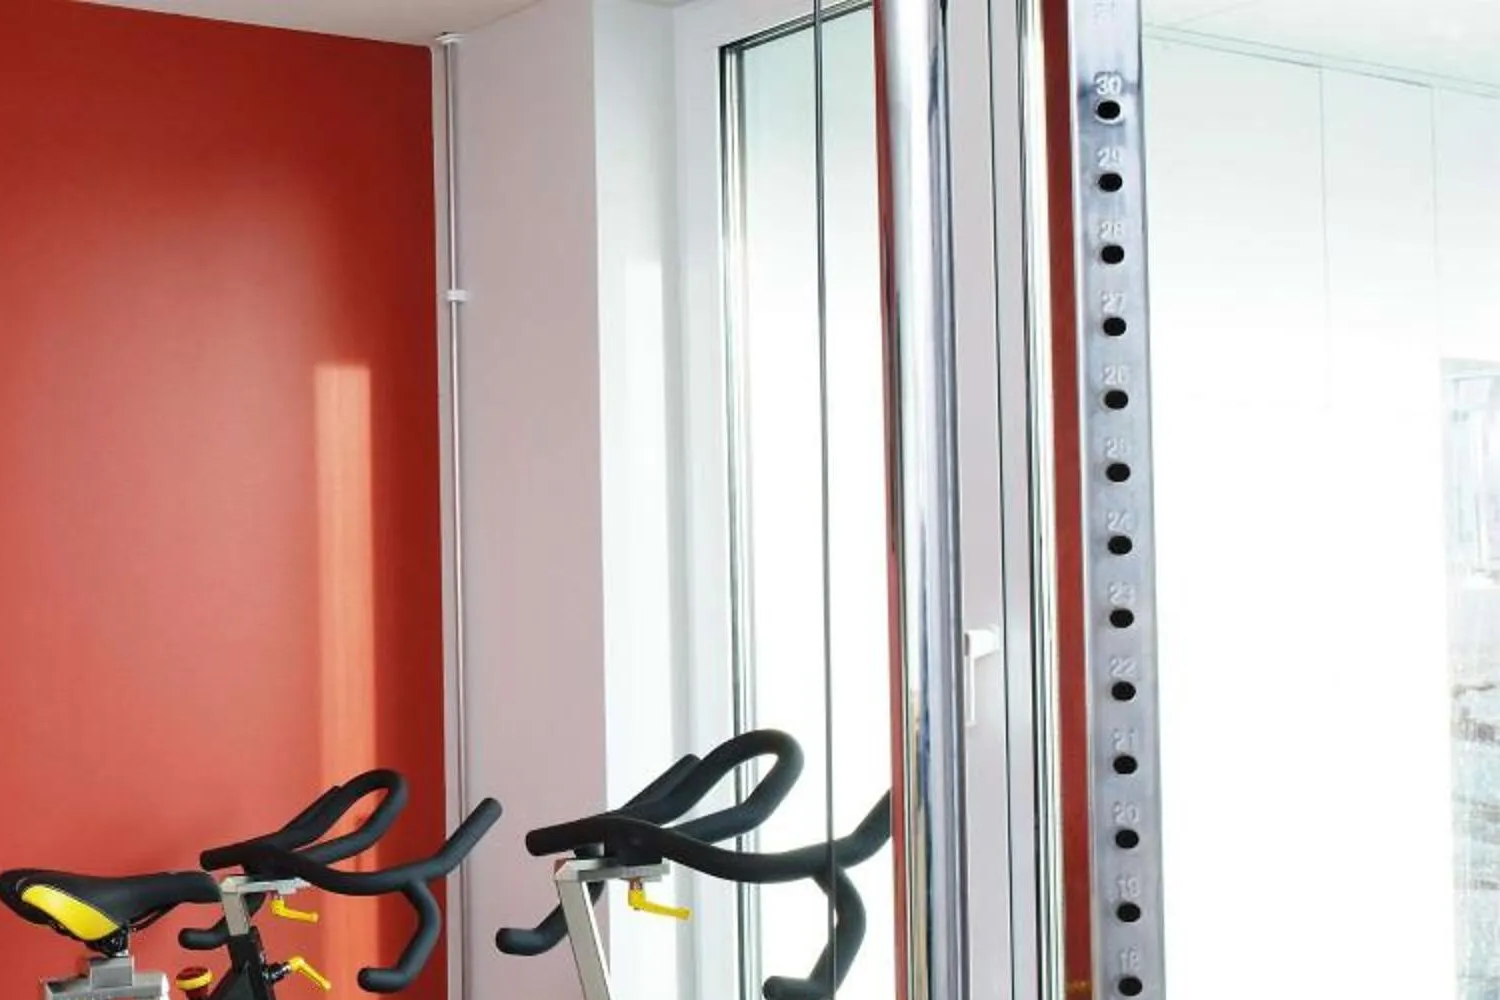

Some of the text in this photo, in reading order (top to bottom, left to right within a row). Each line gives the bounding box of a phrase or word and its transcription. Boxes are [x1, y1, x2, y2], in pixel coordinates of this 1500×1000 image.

[1094, 75, 1122, 95] 30
[1110, 656, 1137, 678] 22
[1112, 729, 1137, 751] 21
[1114, 802, 1140, 824] 20
